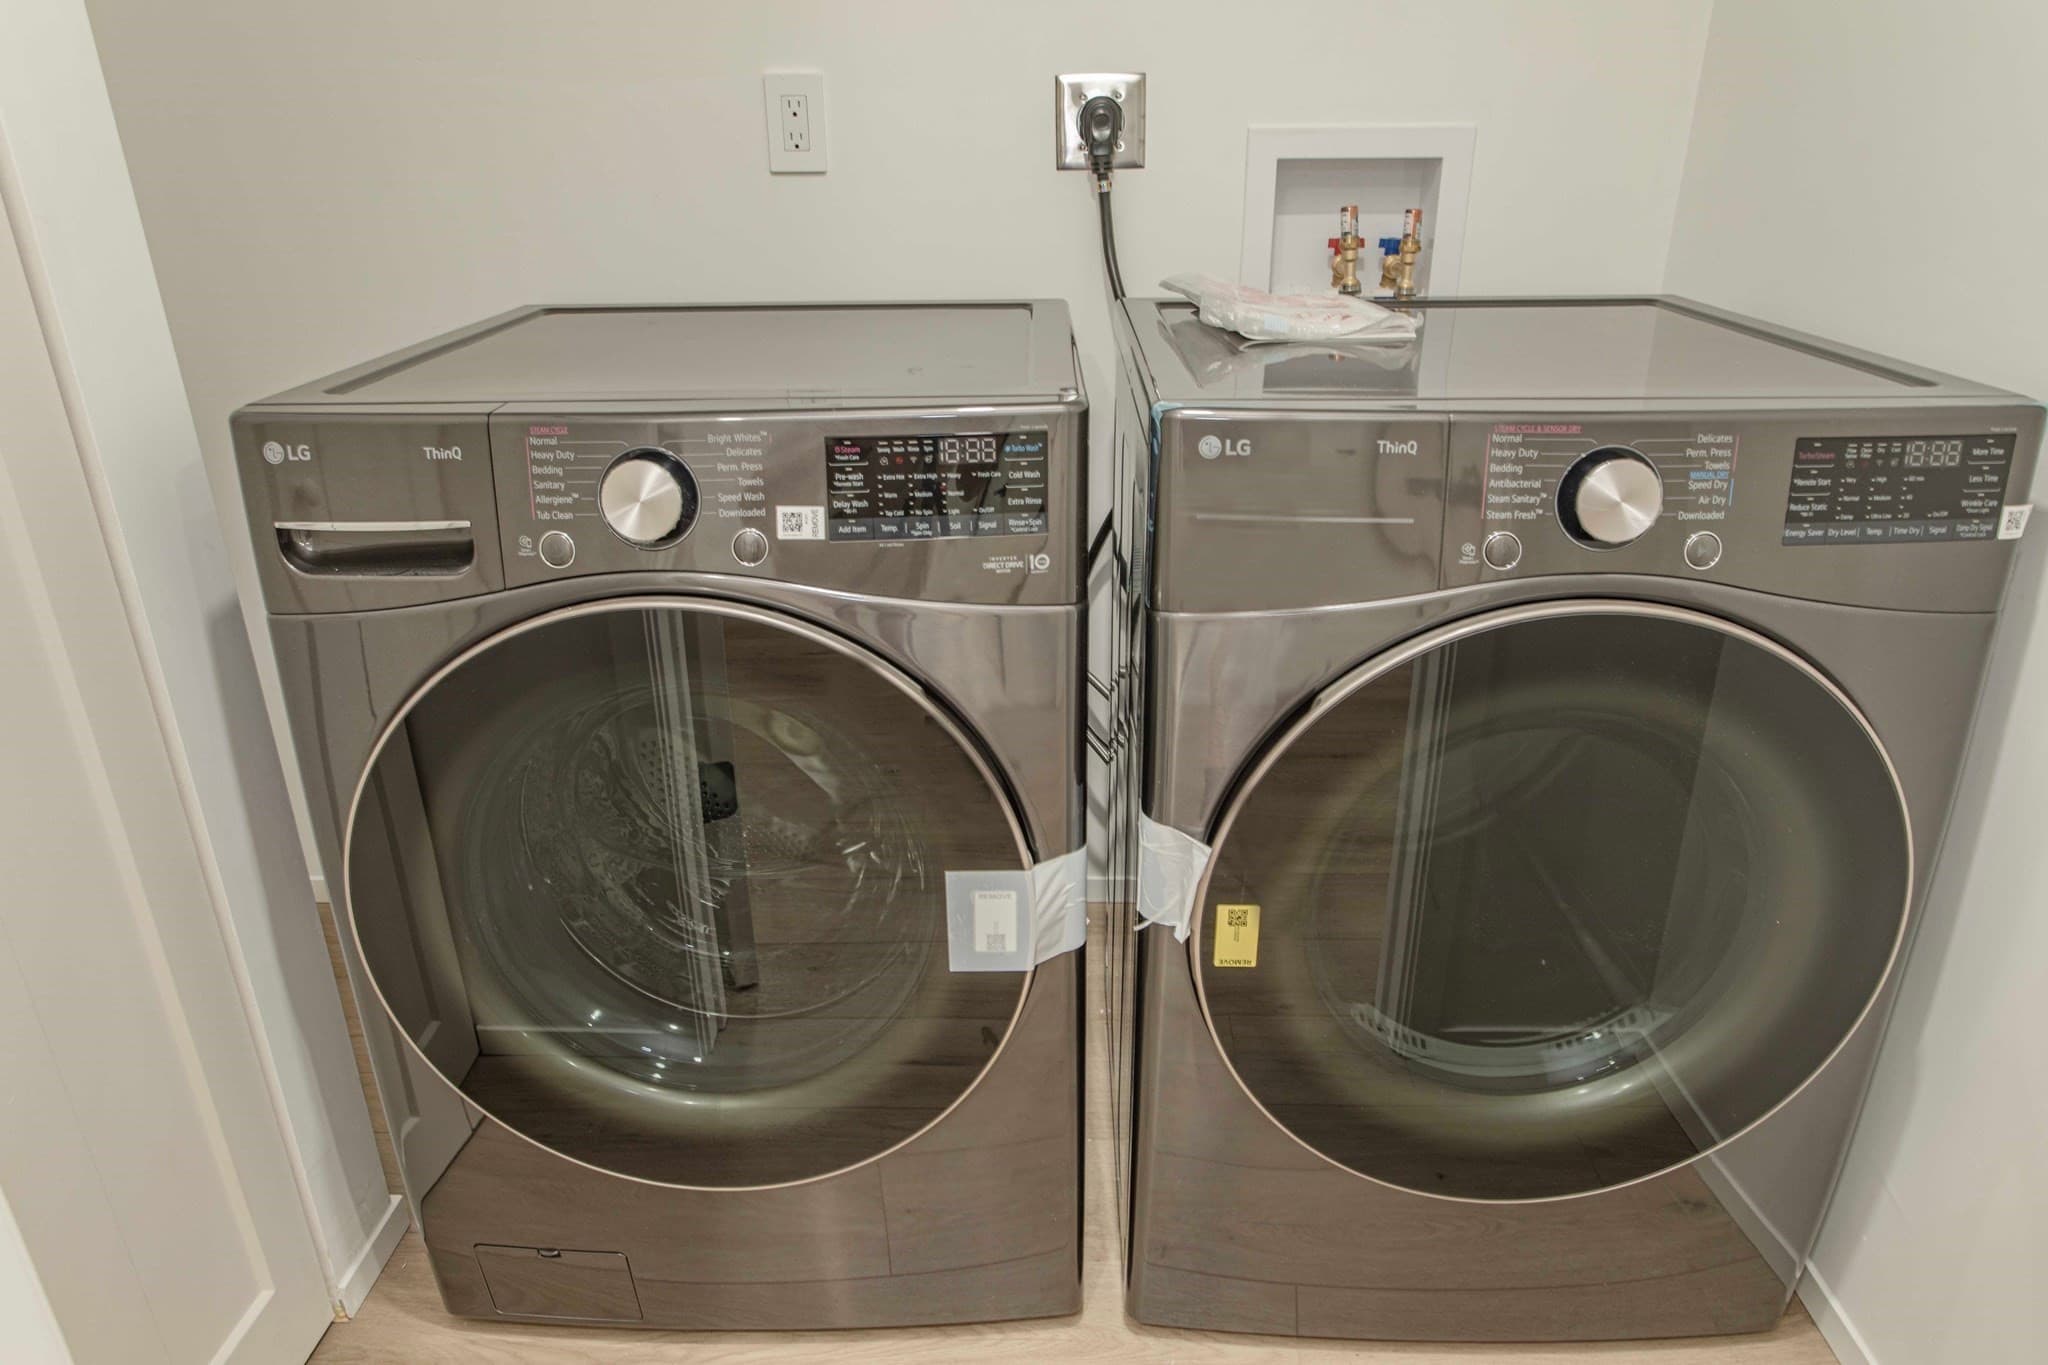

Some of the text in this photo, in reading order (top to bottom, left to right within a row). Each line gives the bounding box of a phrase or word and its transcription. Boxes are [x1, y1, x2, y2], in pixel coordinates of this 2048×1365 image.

[530, 437, 558, 446] Normal
[707, 433, 732, 444] Bright
[1492, 434, 1523, 443] Normal
[1697, 434, 1733, 443] Delicates
[726, 447, 762, 457] Delicates
[1225, 439, 1252, 456] LG
[1377, 440, 1418, 456] ThinQ
[1973, 448, 1989, 456] More
[286, 445, 311, 461] LG
[423, 446, 462, 461] ThinQ
[530, 450, 575, 461] Heavy Duty
[1491, 448, 1539, 459] Heavy Duty
[1710, 448, 1732, 457] Press
[741, 462, 763, 471] Press
[1490, 464, 1523, 475] Bedding
[1705, 461, 1730, 470] Towels
[532, 465, 563, 476] Bedding
[1008, 471, 1023, 479] Cold
[736, 477, 764, 486] Towels
[835, 473, 864, 481] Pre-wash
[1969, 475, 1999, 483] Less Time
[534, 480, 565, 490] Sanitary
[1489, 480, 1542, 489] Antibacterial
[1688, 480, 1728, 491] Speed Dry
[718, 492, 765, 503] Speed Wash
[1025, 497, 1042, 505] Rinse
[1487, 494, 1510, 504] Steam
[1698, 495, 1726, 506] Air Dry
[833, 500, 869, 508] Delay Wash
[537, 511, 574, 519] Tub Clean
[718, 508, 766, 518] Downloaded
[1486, 511, 1512, 520] Steam
[1678, 511, 1725, 520] Downloaded
[916, 521, 930, 530] Spin
[949, 522, 962, 530] Soil
[979, 521, 997, 530] Signal
[1784, 529, 1825, 538] Energy Saver
[1827, 528, 1857, 538] Dry Level
[1893, 526, 1920, 536] Time Dry
[1929, 526, 1948, 535] Signal
[983, 560, 1024, 569] DIRECT DRIVE
